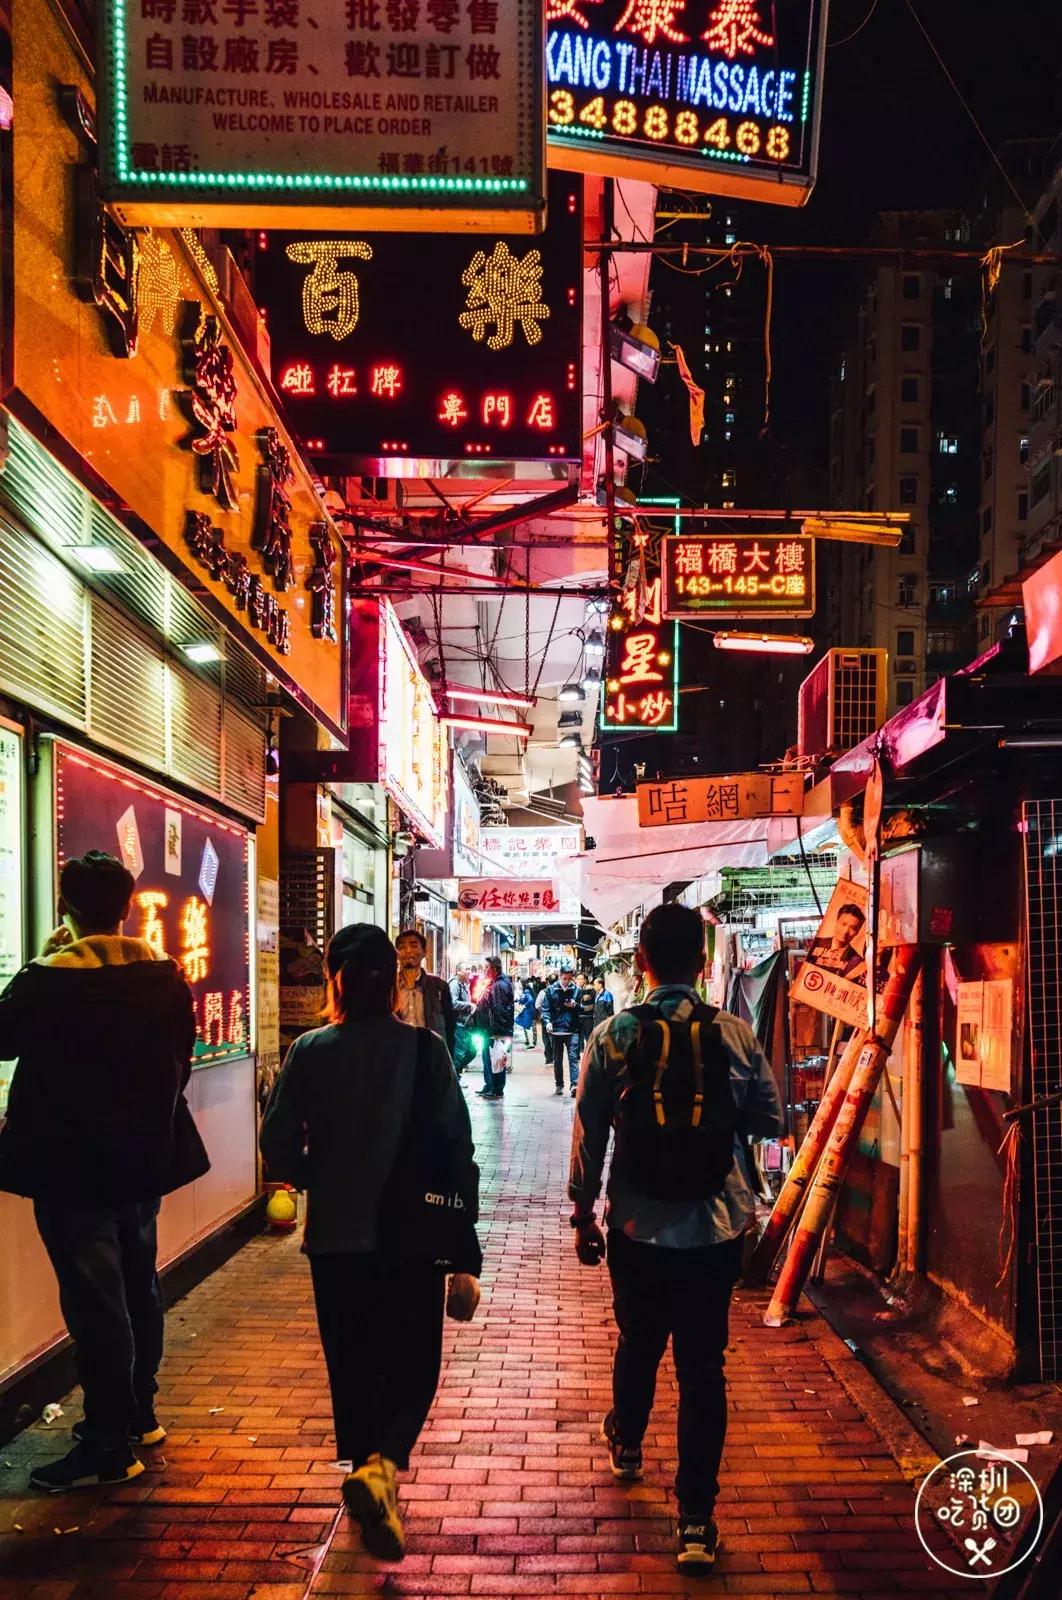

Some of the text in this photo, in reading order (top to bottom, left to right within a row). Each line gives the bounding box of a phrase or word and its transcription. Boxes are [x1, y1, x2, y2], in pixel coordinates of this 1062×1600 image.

[145, 32, 500, 79] 自設廠房、歡迎訂做
[616, 42, 671, 99] THAI
[676, 54, 796, 122] MASSAGE
[284, 90, 381, 111] WHOLESALE
[384, 93, 421, 111] AND
[424, 94, 498, 113] RETAILER
[213, 113, 431, 136] WELCOME TO PLACE ORDER
[549, 89, 790, 159] 34888468
[439, 394, 552, 427] 專門店
[675, 542, 805, 574] 福橋大樓
[606, 691, 671, 724] 小炒
